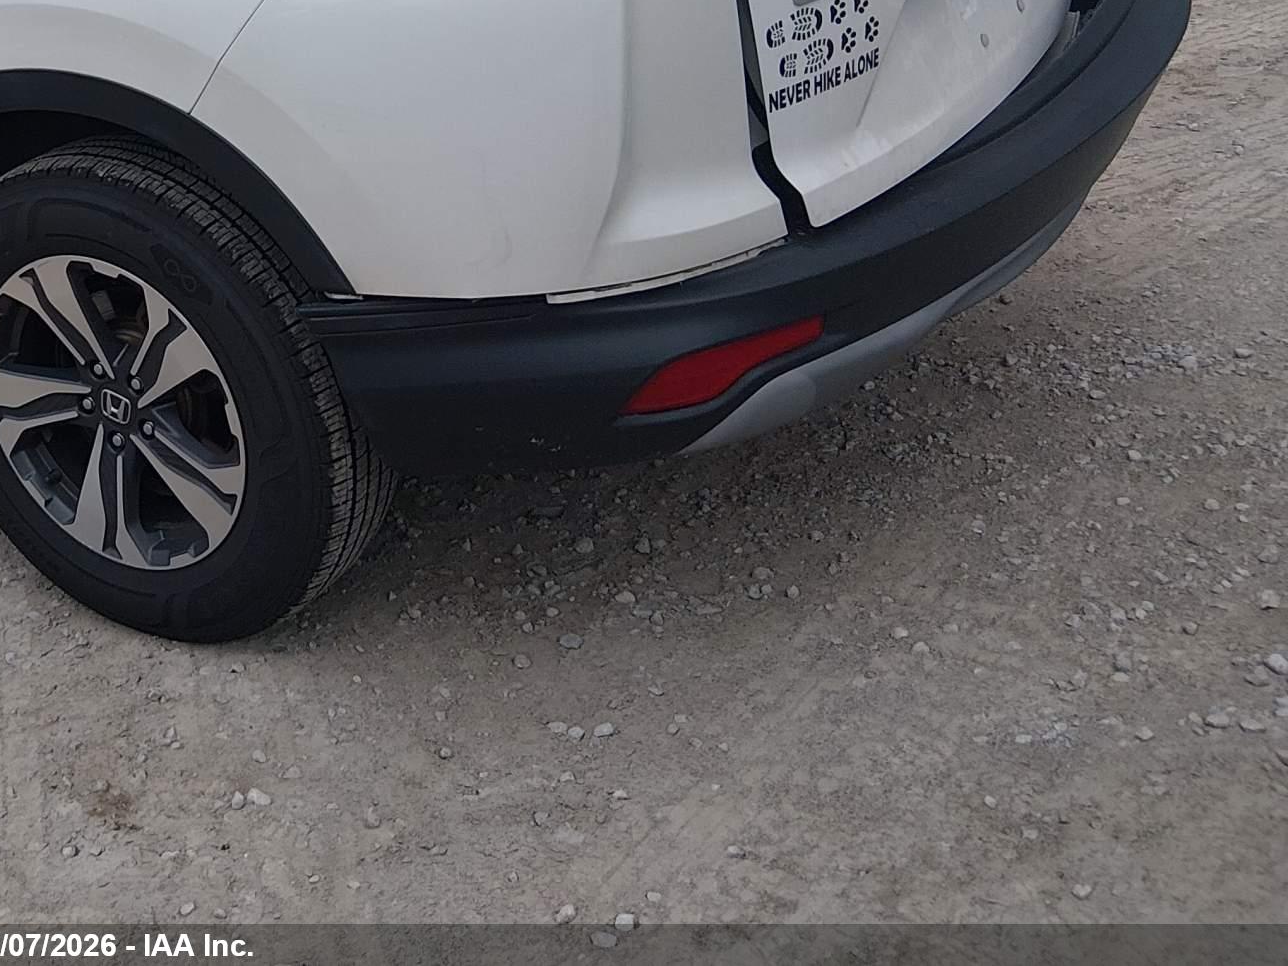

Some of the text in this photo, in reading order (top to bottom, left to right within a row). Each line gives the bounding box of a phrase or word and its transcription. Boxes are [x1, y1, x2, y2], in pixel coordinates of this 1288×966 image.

[768, 48, 879, 113] NEVER HIKE ALONE
